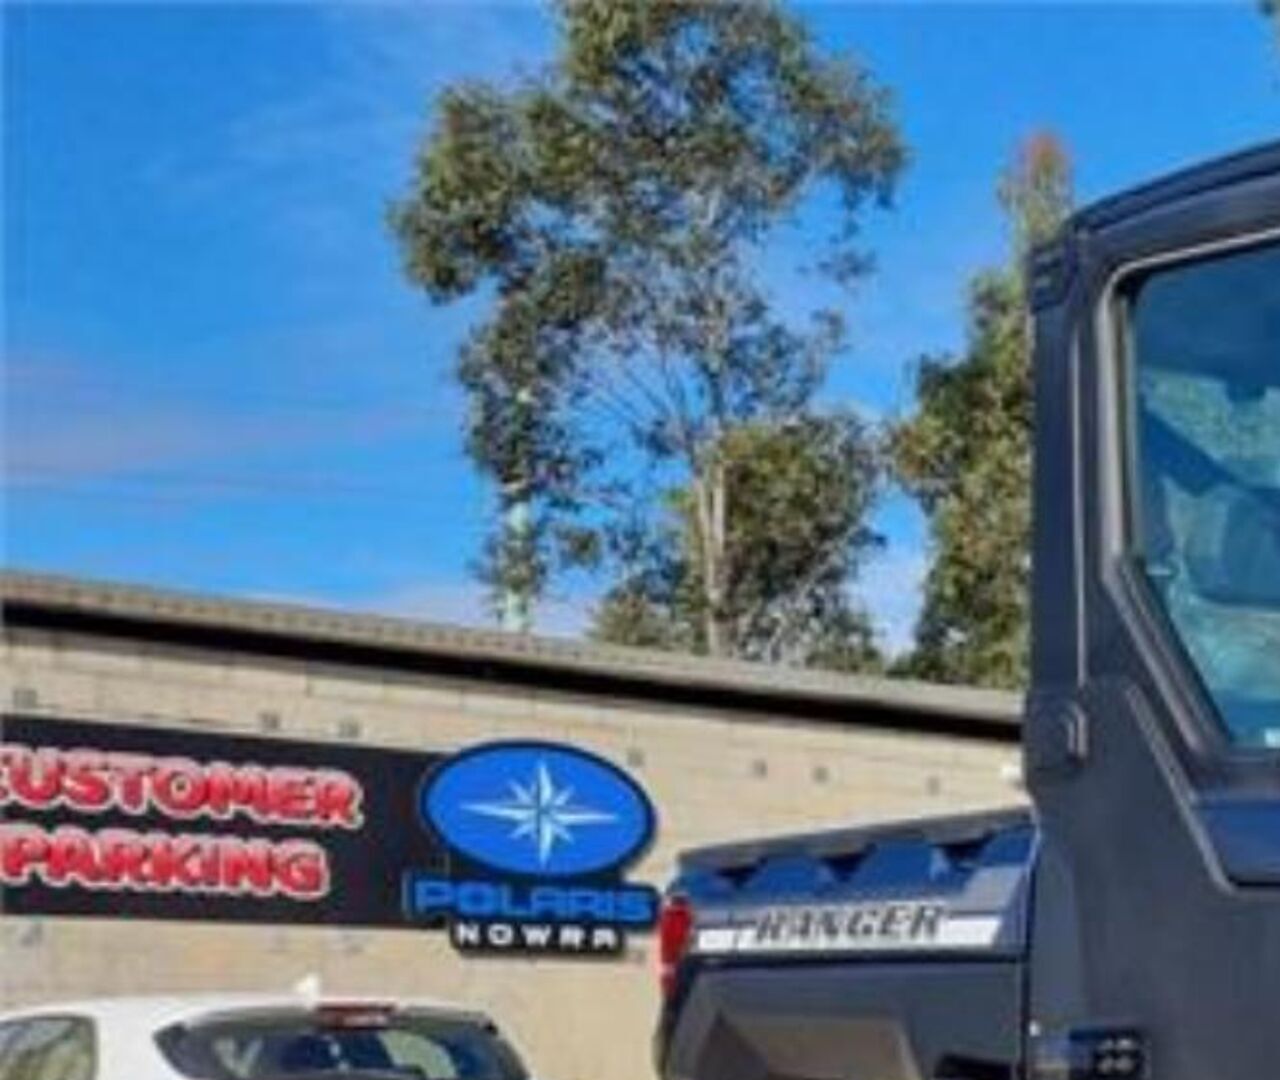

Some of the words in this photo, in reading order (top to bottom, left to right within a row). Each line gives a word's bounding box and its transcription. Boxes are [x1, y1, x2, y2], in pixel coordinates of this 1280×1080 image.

[0, 743, 364, 829] USTOMER
[0, 823, 331, 899] PARKING
[413, 878, 653, 922] POLARIS
[756, 903, 945, 941] RANGER
[456, 923, 619, 948] NOWRA
